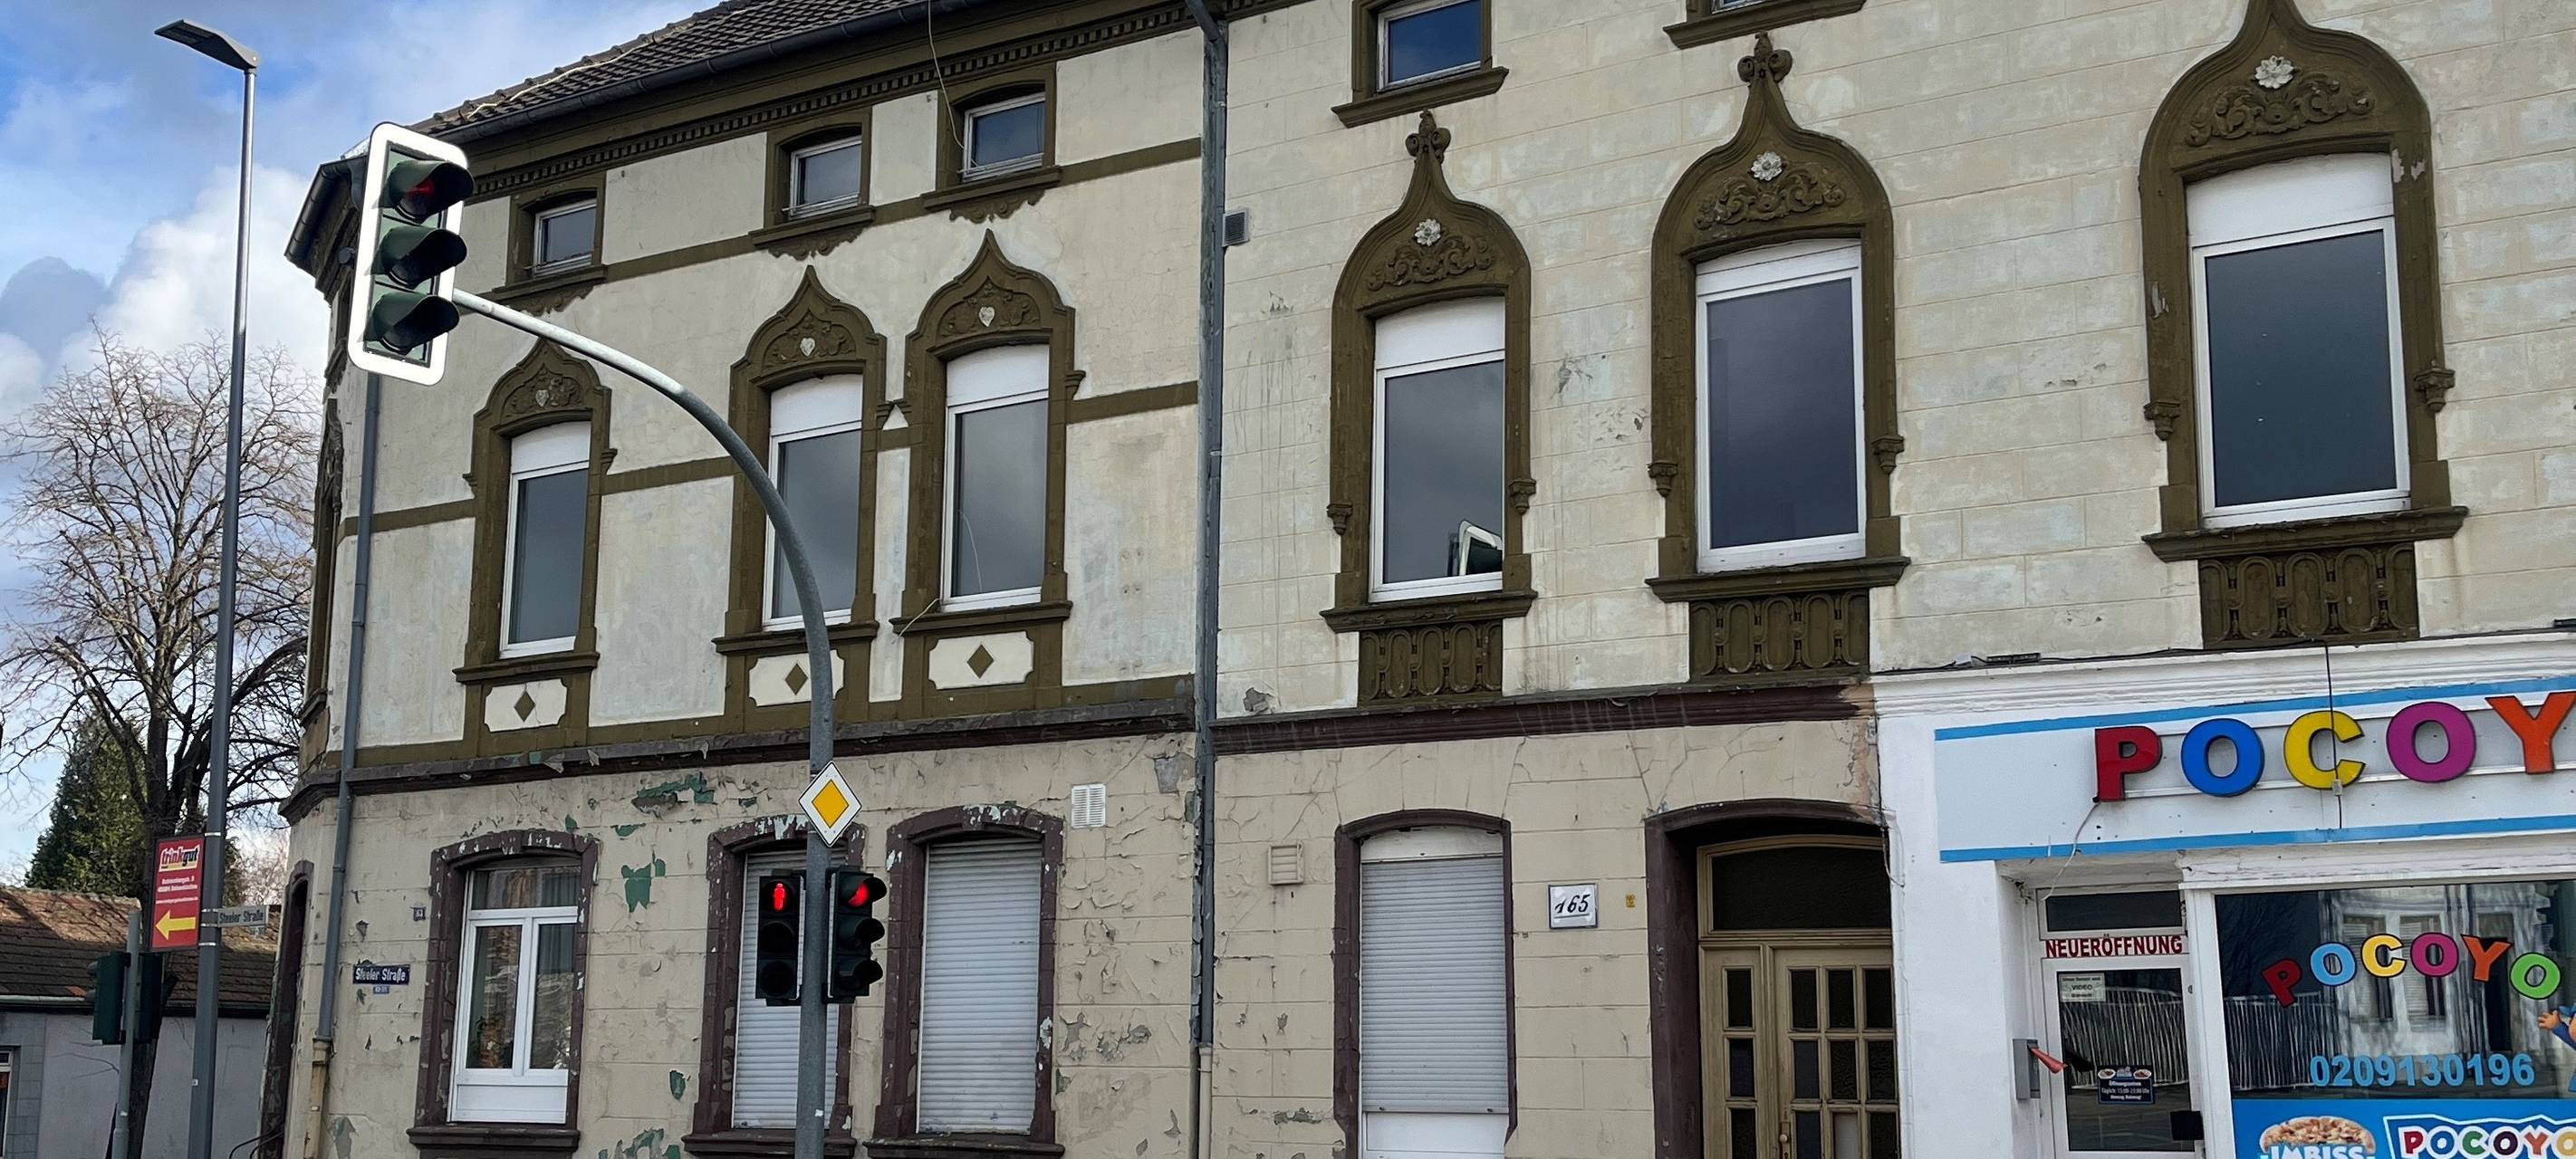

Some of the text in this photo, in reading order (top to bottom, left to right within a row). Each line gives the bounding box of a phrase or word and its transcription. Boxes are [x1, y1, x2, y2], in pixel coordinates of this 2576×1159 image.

[2094, 693, 2576, 802] POCOY
[160, 845, 199, 867] trinkgut
[1554, 893, 1591, 914] 165
[243, 909, 264, 923] Straße
[2046, 934, 2183, 958] NEUERÖFFNUNG
[355, 967, 406, 982] Steeler Straße
[2261, 932, 2561, 1008] POCOYO
[2310, 1053, 2535, 1087] 0209130196
[2401, 1126, 2576, 1158] POCOYO
